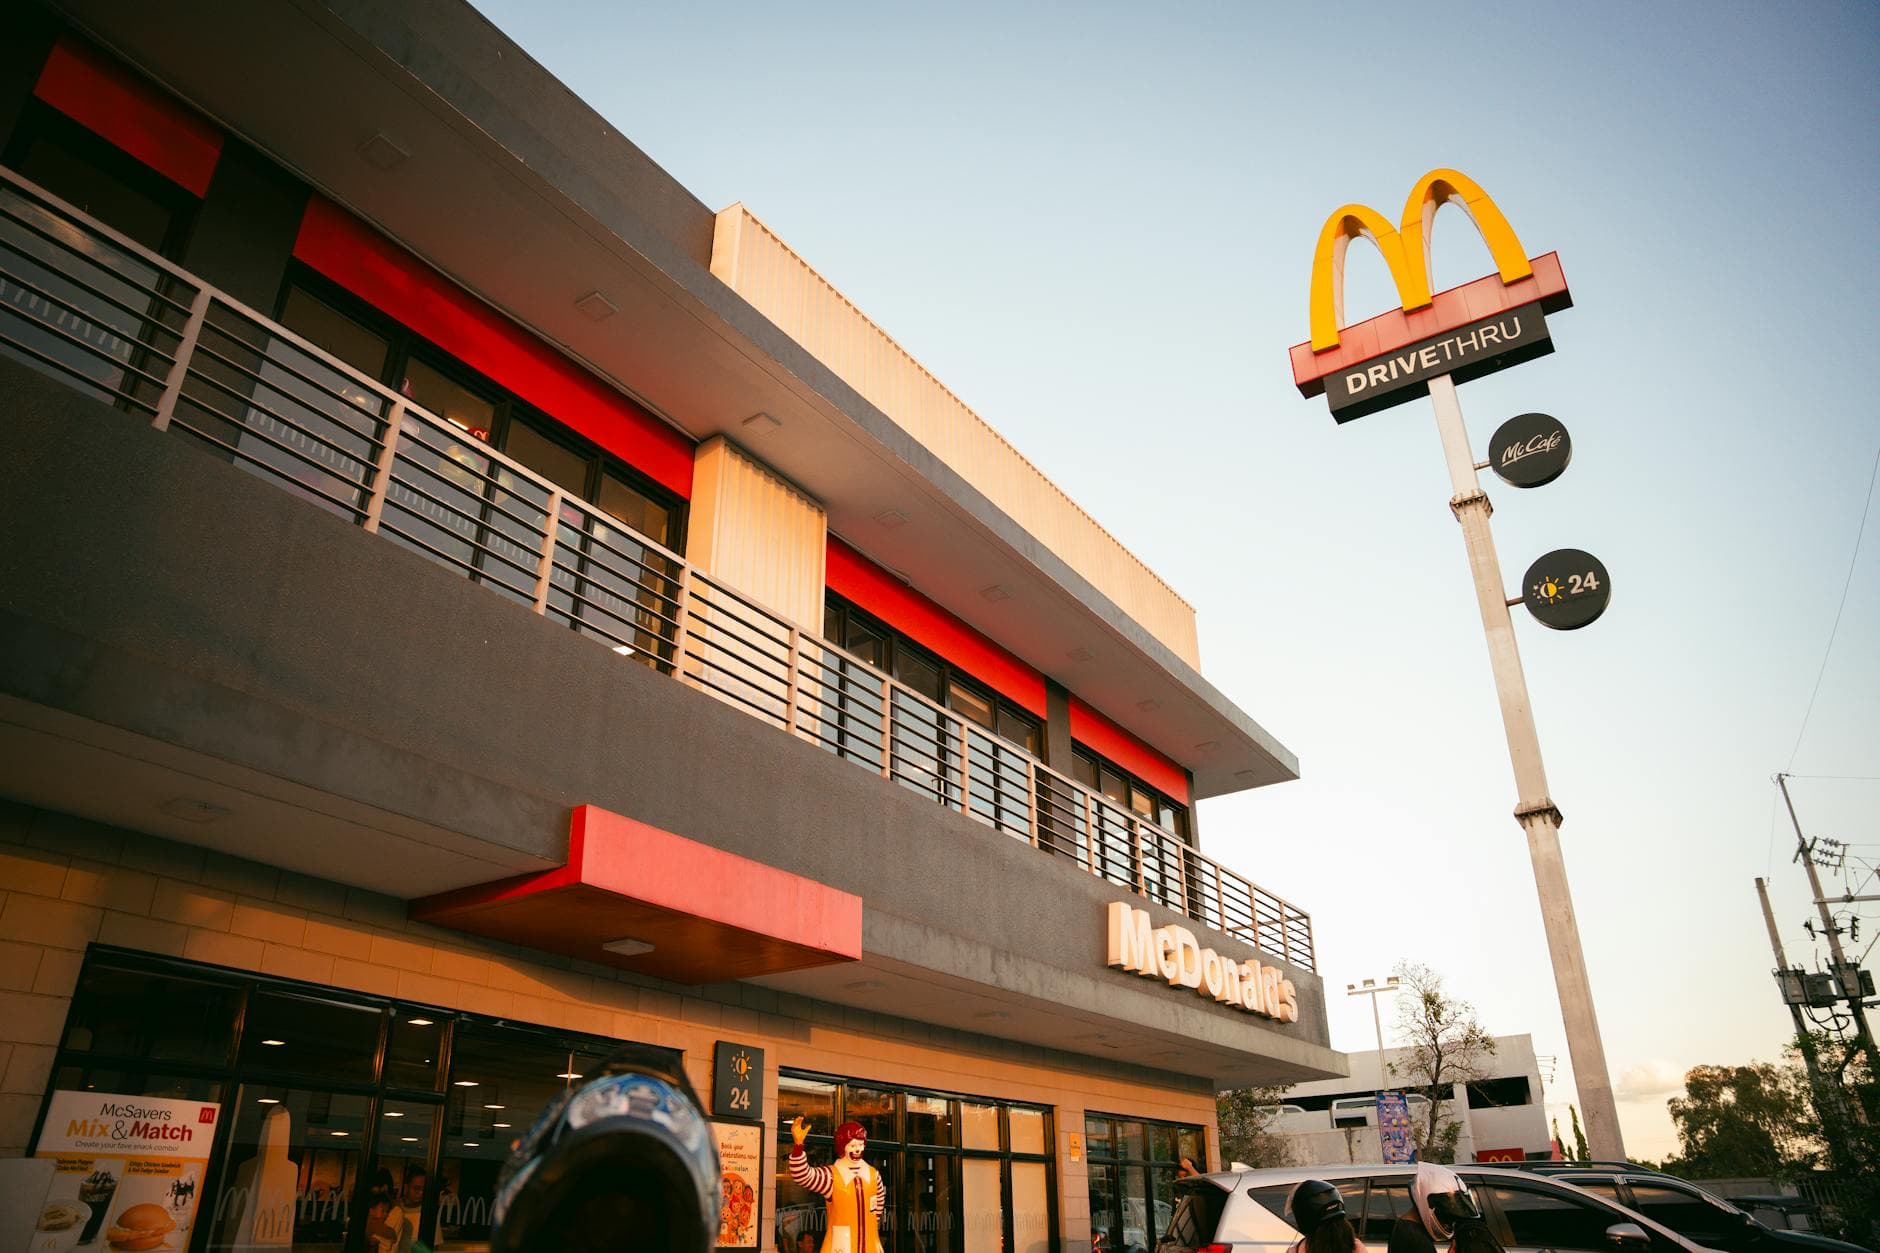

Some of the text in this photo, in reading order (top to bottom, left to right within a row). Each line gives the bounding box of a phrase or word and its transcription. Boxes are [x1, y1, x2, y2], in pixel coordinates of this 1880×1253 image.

[1567, 571, 1600, 595] 24
[1107, 901, 1299, 1024] McDonald's
[730, 1087, 750, 1110] 24
[99, 1103, 172, 1121] McSavers
[66, 1119, 111, 1138] Mix
[129, 1120, 193, 1142] Match
[75, 1140, 100, 1149] Create
[100, 1142, 117, 1150] your
